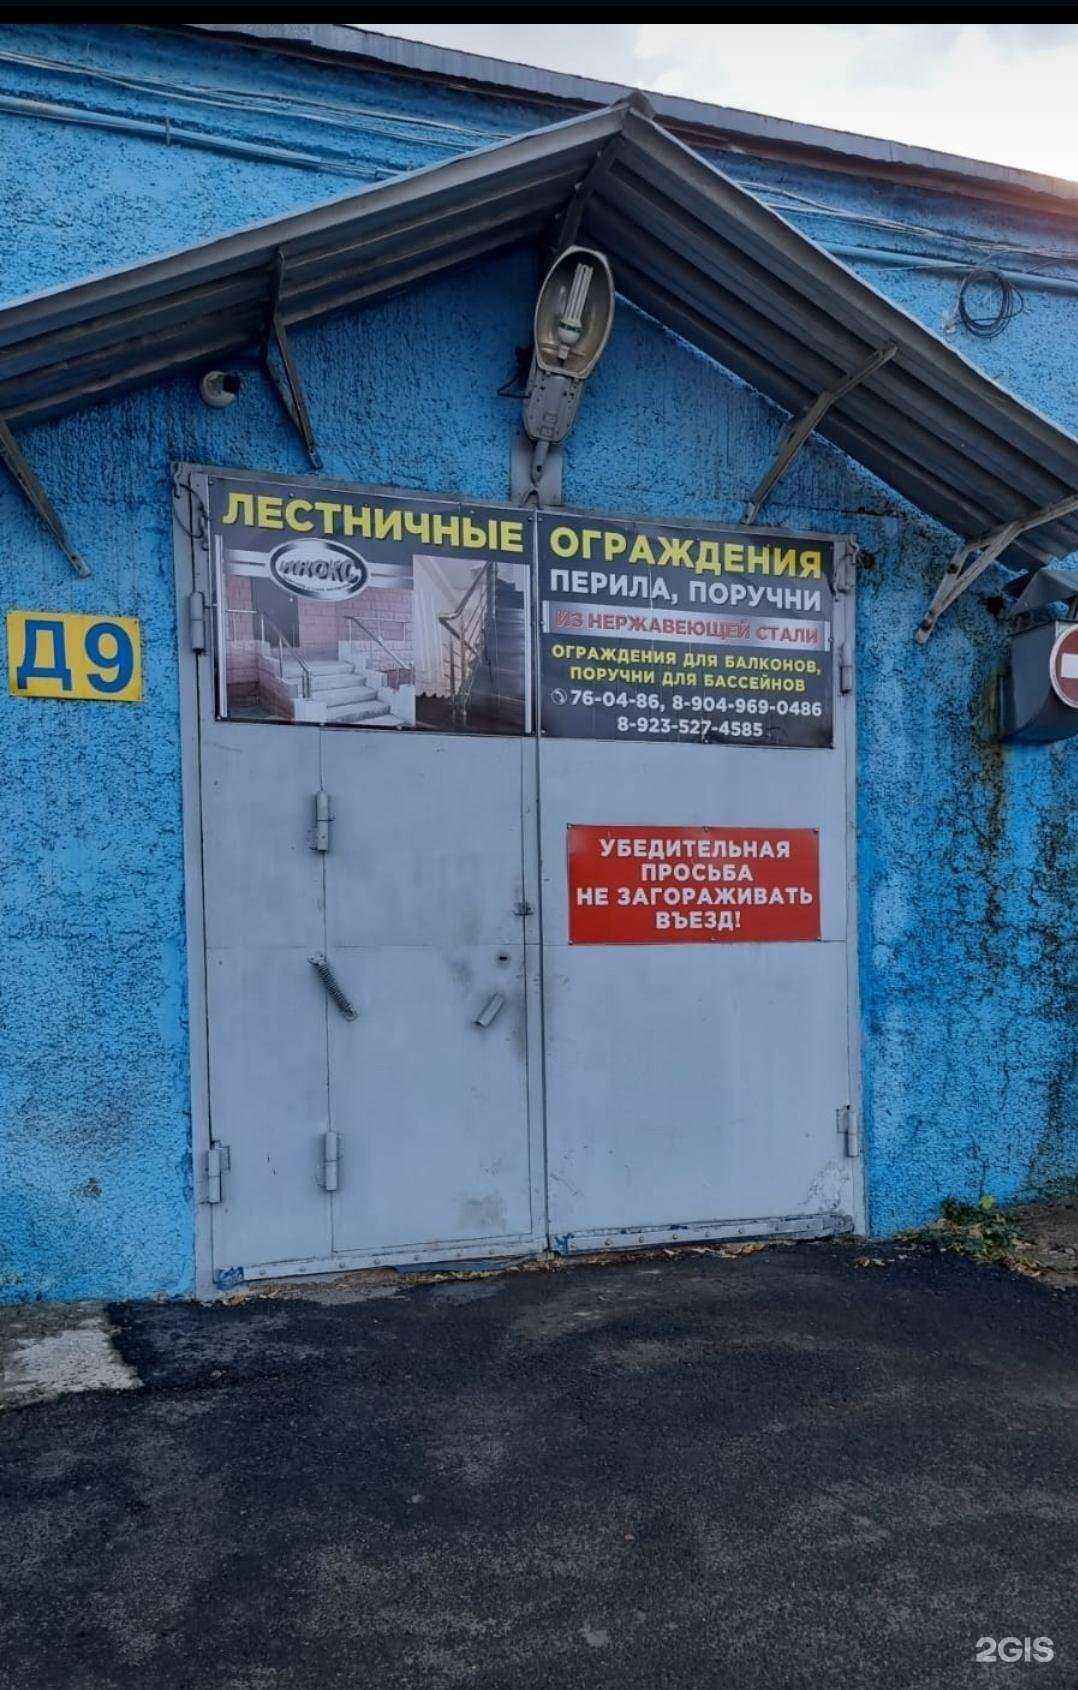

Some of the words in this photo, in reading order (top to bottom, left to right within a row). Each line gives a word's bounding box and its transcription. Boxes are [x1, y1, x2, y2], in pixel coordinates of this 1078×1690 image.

[222, 491, 524, 553] ЛЕСТНИЧНЫЕ
[550, 526, 822, 579] ОГРАЖДЕНИЯ
[550, 568, 679, 605] ПЕРИЛА,
[689, 580, 822, 612] ПОРУЧНИ
[555, 608, 583, 627] ИЗ
[587, 611, 751, 642] НЕРЖАВЕЮЩЕЙ
[755, 625, 820, 645] СТАЛИ
[17, 619, 134, 693] Д9
[552, 644, 677, 665] ОГРАЖДЕНИЯ
[683, 652, 718, 669] ДЛЯ
[725, 655, 823, 675] БАЛКОНОВ,
[570, 666, 655, 684] ПОРУЧНИ
[661, 673, 697, 687] ДЛЯ
[704, 673, 806, 692] БАССЕЙНОВ
[570, 689, 667, 713] 76-04-86,
[672, 694, 823, 717] 8-904-969-0486
[617, 716, 764, 738] 8-923-527-4585
[599, 838, 791, 860] УБЕДИТЕЛЬНАЯ
[641, 863, 754, 882] ПРОСЬБА
[576, 886, 609, 906] НЕ
[617, 886, 813, 906] ЗАГОРАЖИВАТЬ
[656, 911, 742, 932] ВЪЕЗД!
